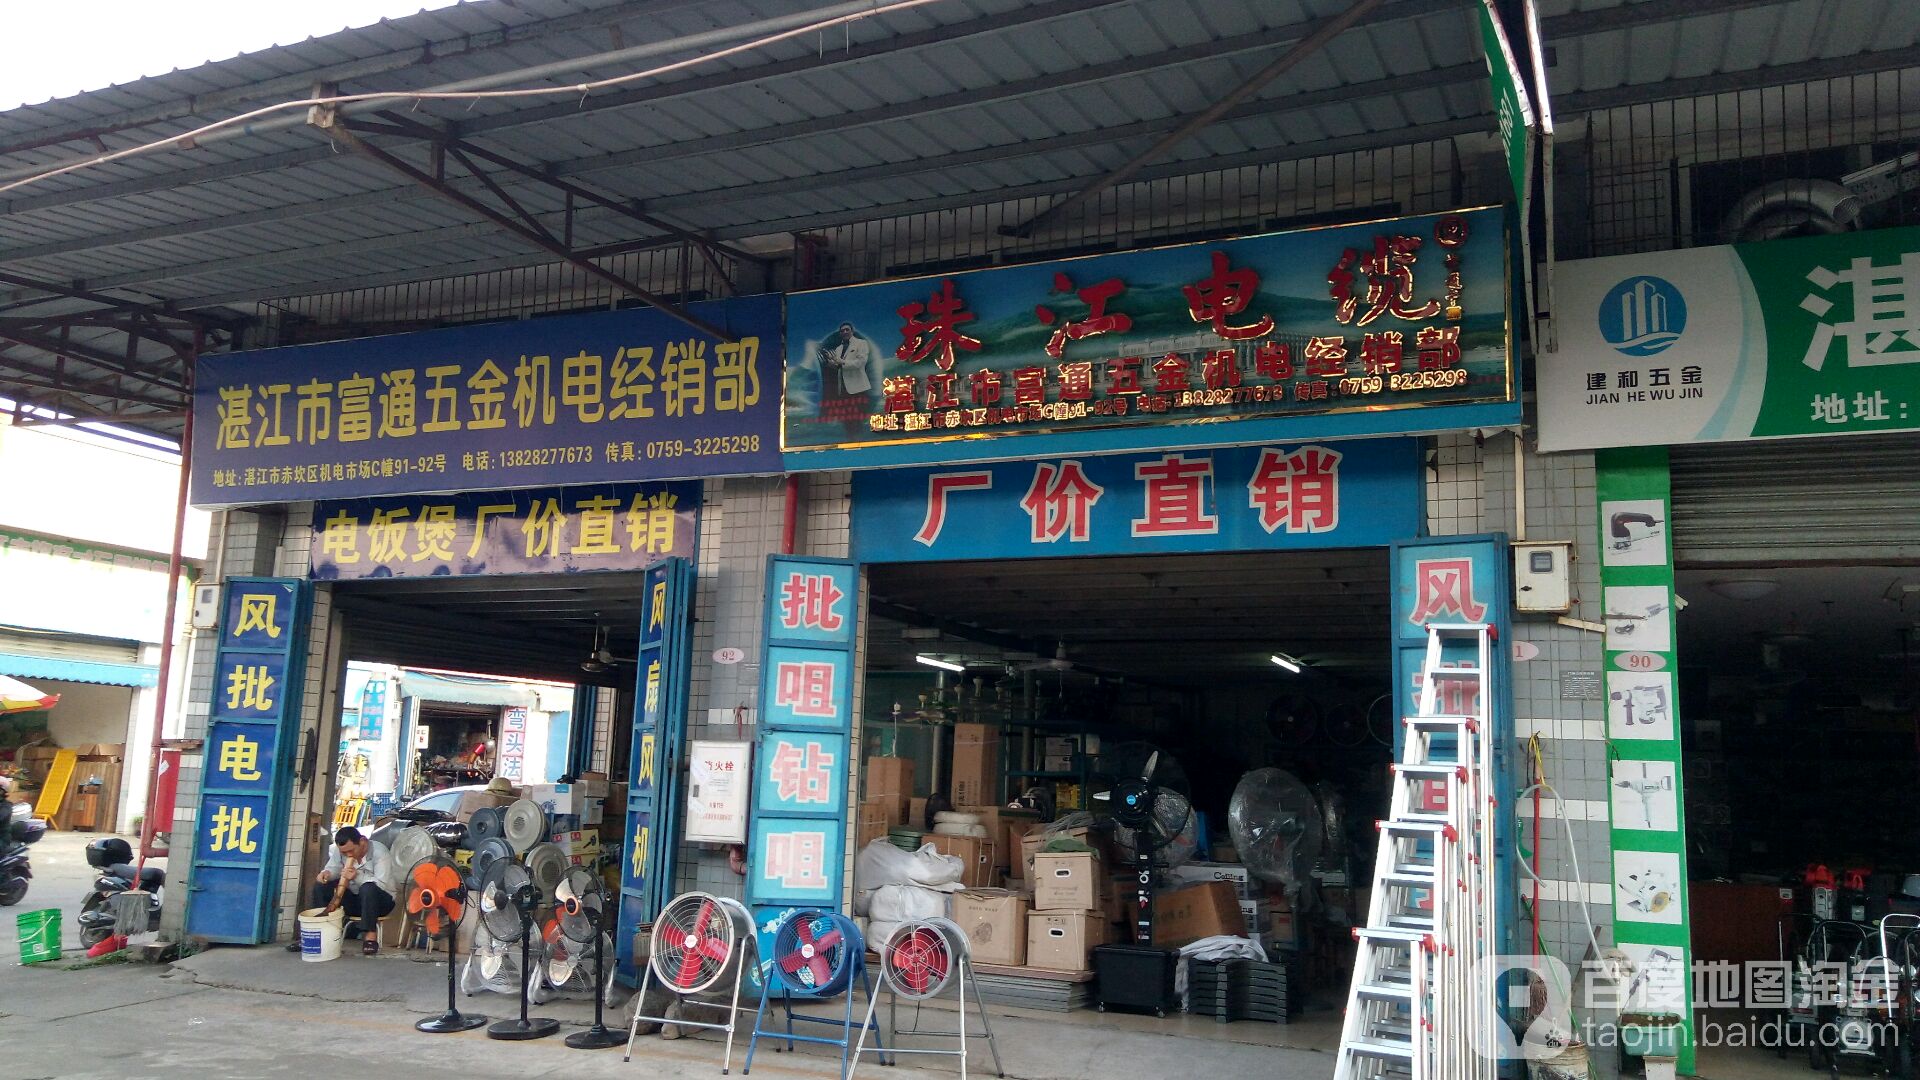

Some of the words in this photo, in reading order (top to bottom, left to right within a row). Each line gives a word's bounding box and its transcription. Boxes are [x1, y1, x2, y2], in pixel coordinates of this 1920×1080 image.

[1799, 251, 1920, 372] 湛
[216, 336, 761, 451] 湛江市富通五金机电经销部
[882, 325, 1462, 414] 湛江市富通五金机电经销部
[1586, 365, 1703, 391] 建和五金
[1586, 393, 1620, 405] JIAN
[1627, 391, 1646, 402] HE
[1650, 388, 1676, 401] WU
[1679, 386, 1704, 399] JIN
[323, 490, 679, 564] 电饭煲厂价直销
[913, 444, 1340, 548] 厂价直销
[721, 650, 736, 661] 92
[1629, 655, 1651, 668] 90
[210, 593, 282, 854] 风批电批
